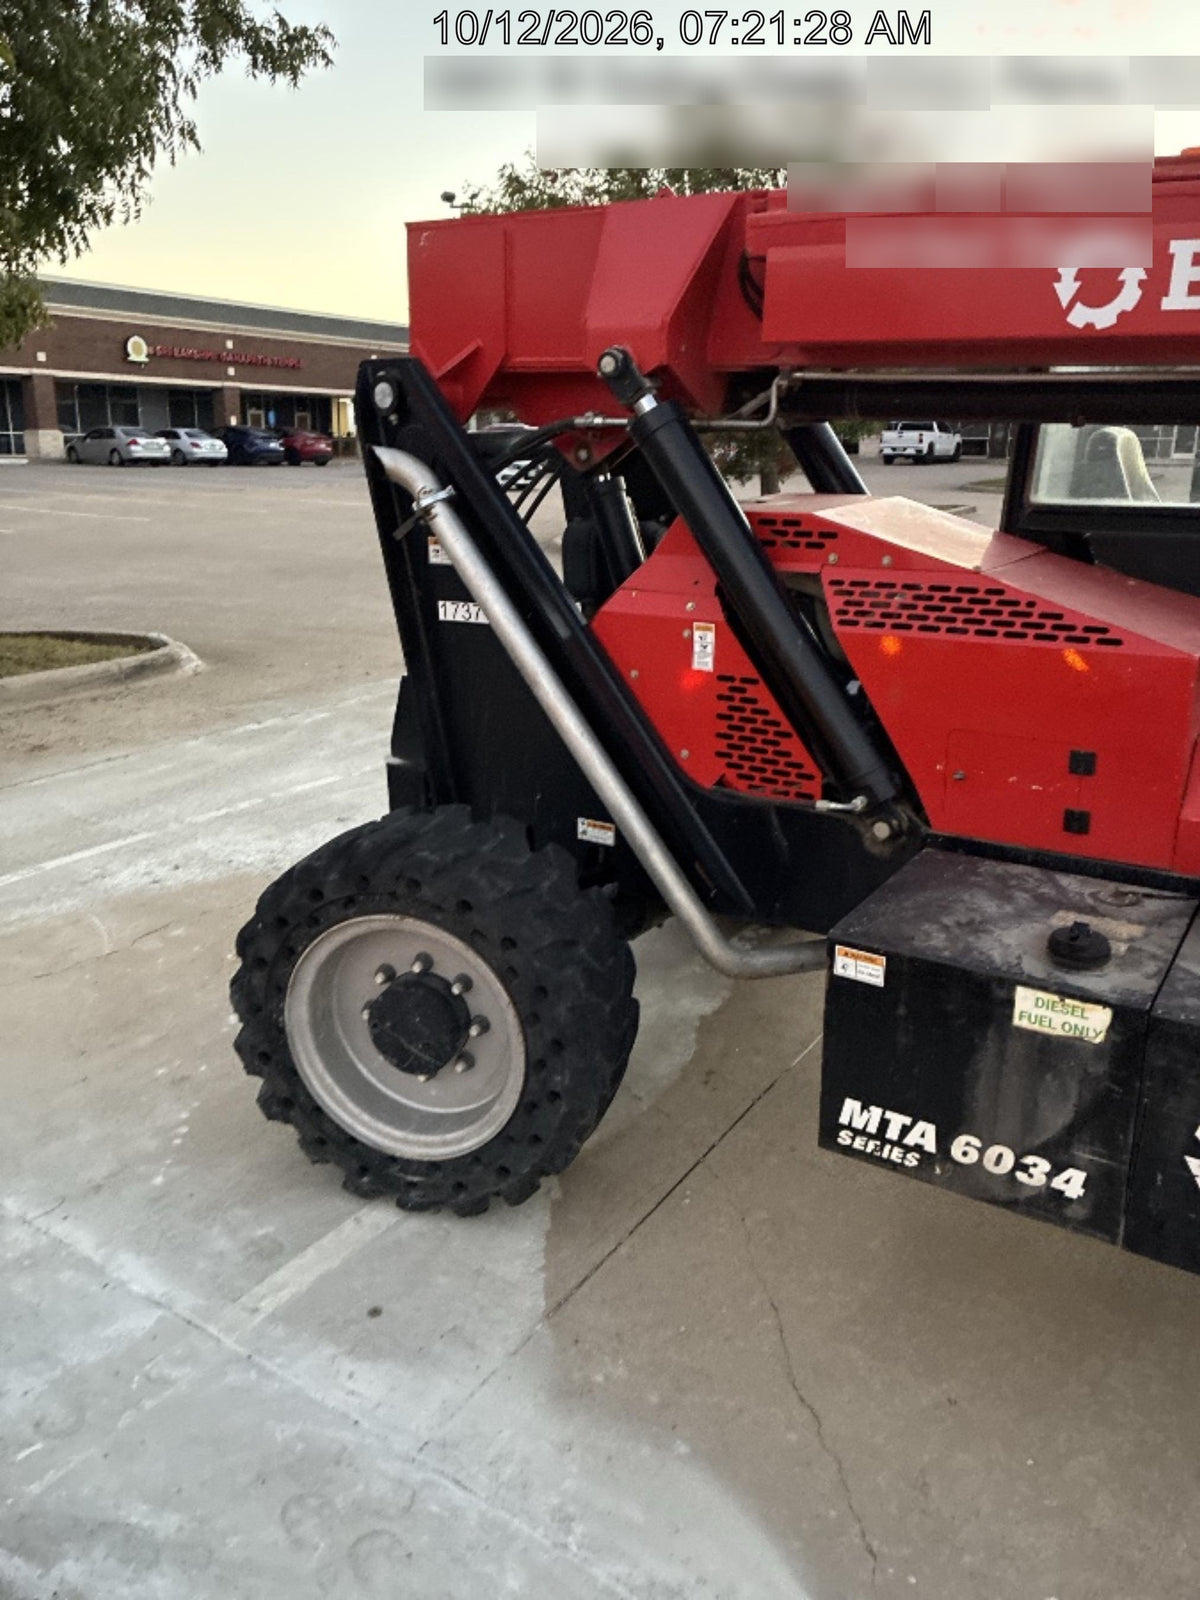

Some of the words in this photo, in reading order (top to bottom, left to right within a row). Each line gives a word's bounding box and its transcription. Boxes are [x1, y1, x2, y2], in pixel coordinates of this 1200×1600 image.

[1018, 1010, 1057, 1030] FUEL
[1060, 1020, 1104, 1039] ONLY
[1034, 996, 1089, 1020] DIESEL
[836, 1129, 921, 1168] SERIES
[838, 1097, 937, 1154] MTA
[950, 1133, 1087, 1200] 6034
